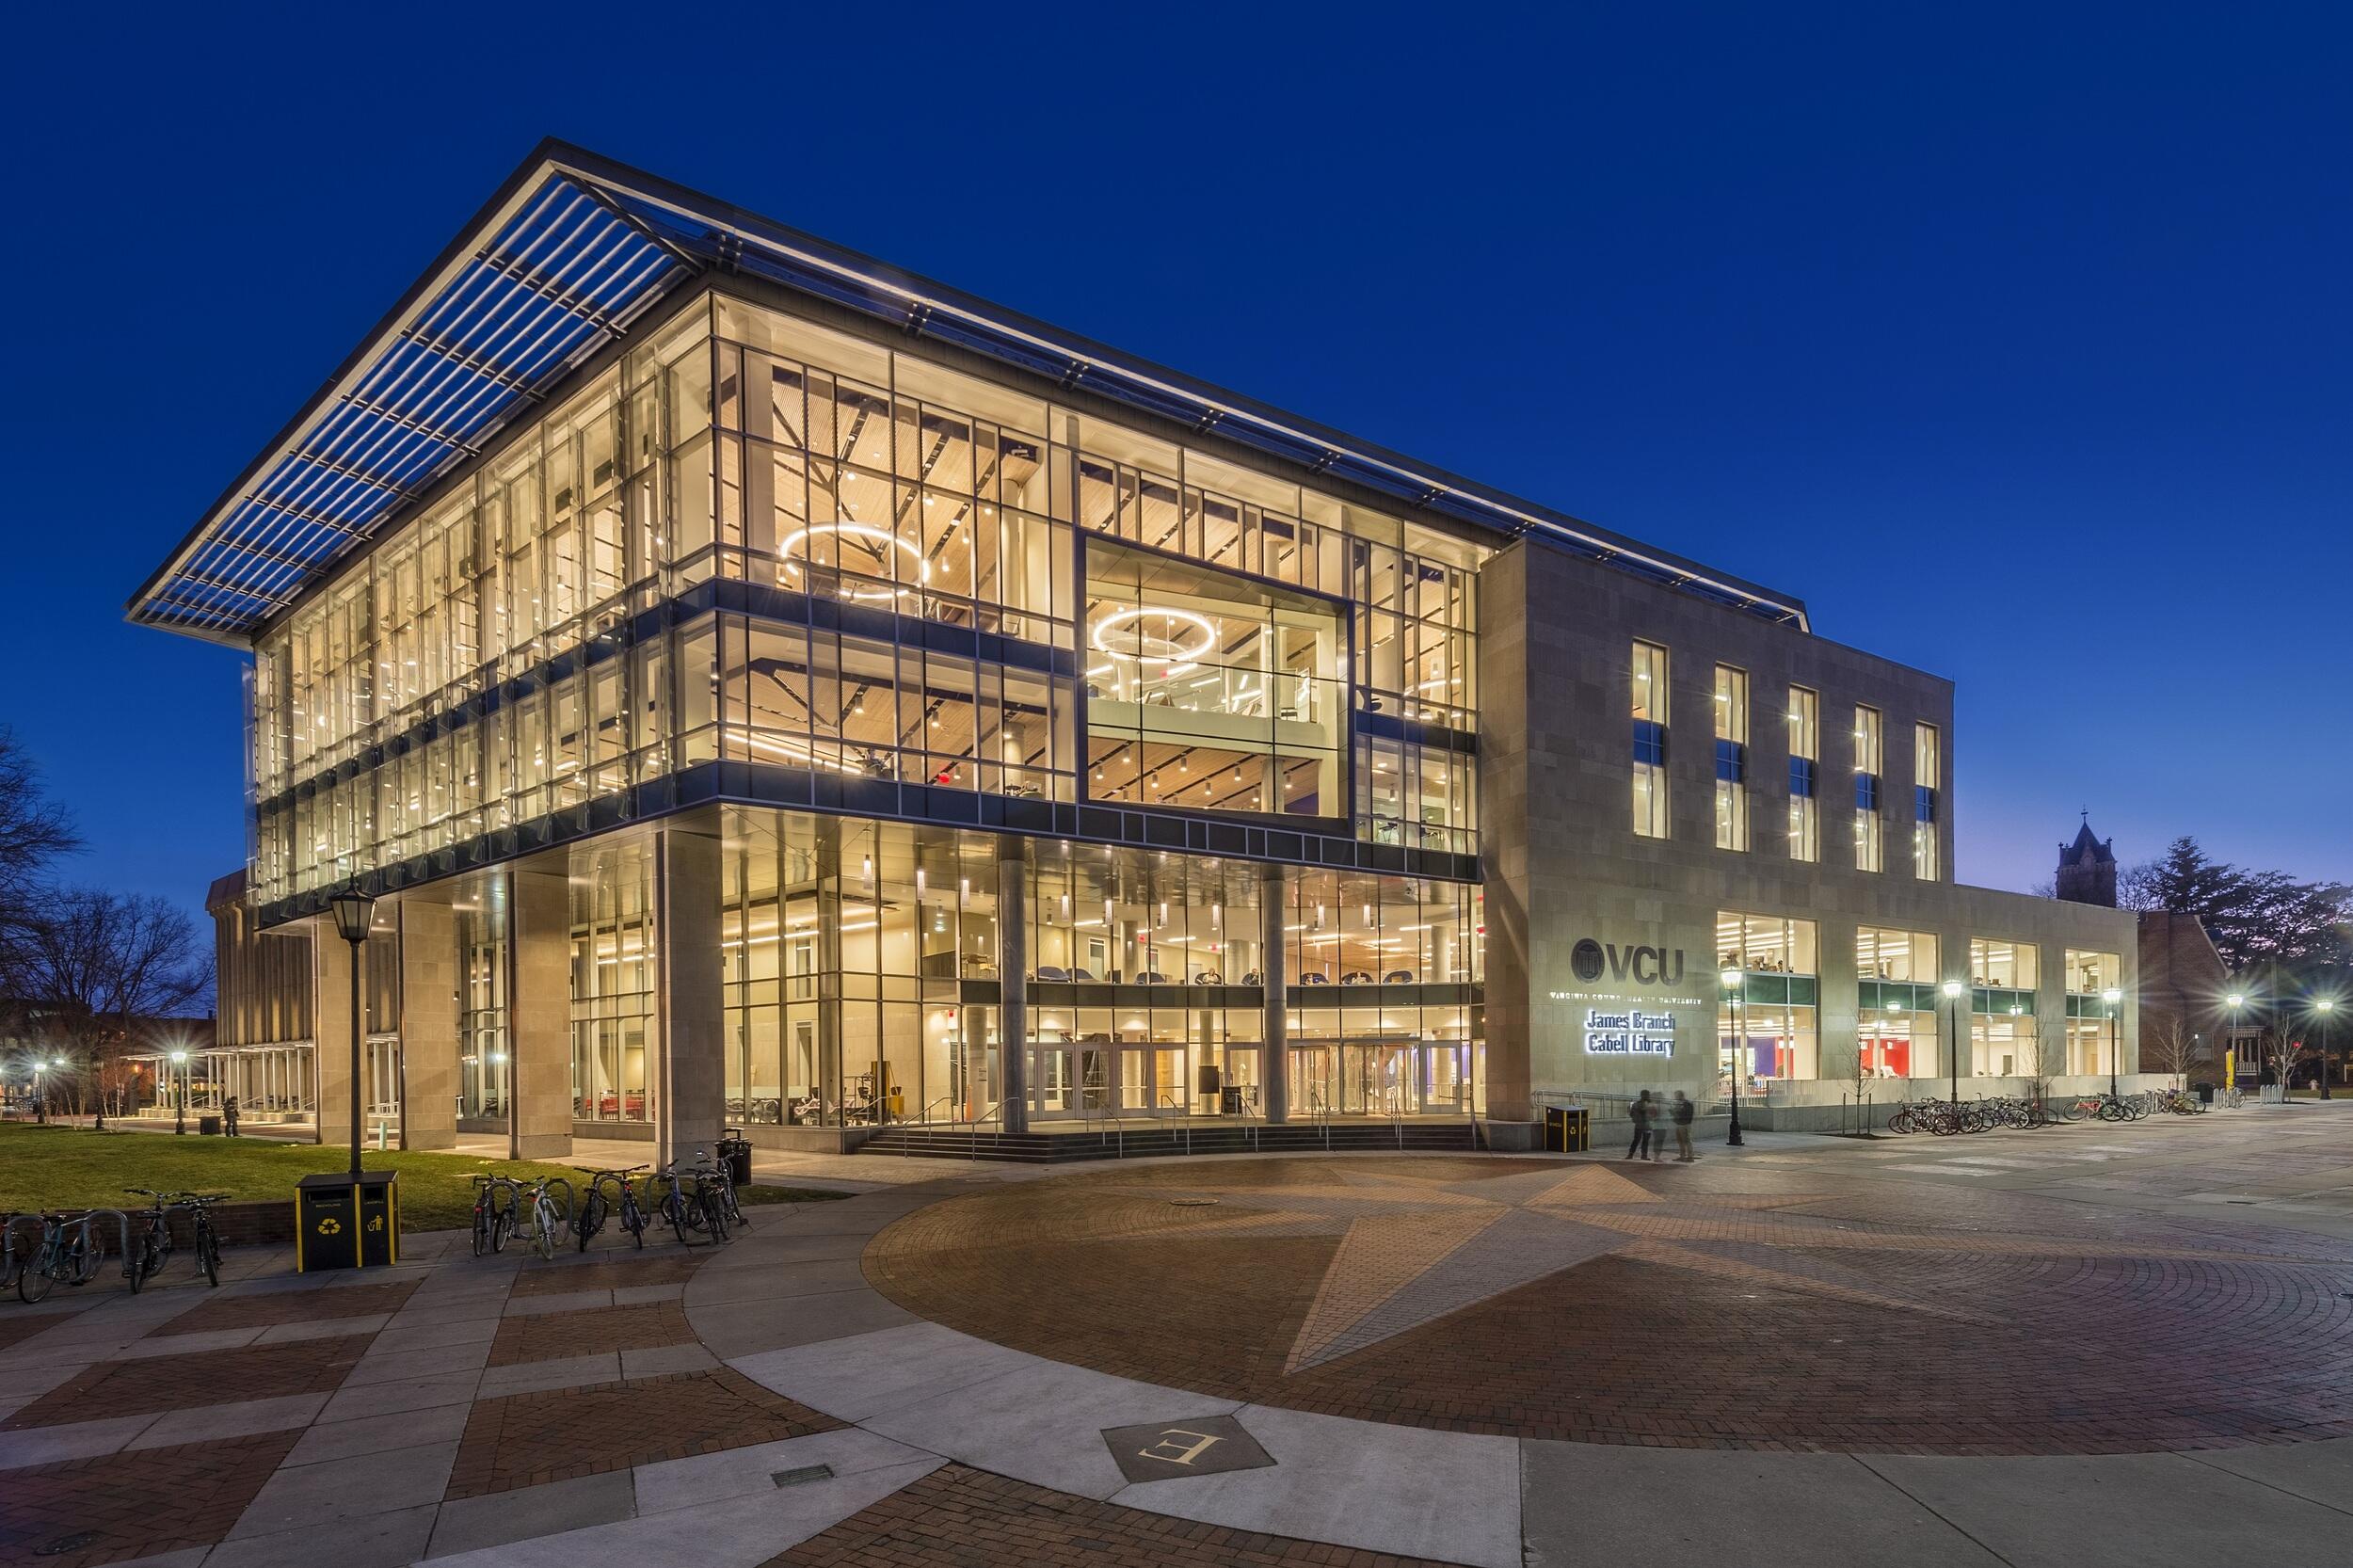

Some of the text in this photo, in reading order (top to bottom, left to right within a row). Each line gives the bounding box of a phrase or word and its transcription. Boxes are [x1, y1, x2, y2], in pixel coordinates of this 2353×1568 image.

[1605, 943, 1684, 986] VCU
[1549, 991, 1702, 1005] VIRGINIA COMMOWEALTH UNIVERSITY
[1586, 1010, 1675, 1031] James Branch
[1587, 1033, 1675, 1057] Cabell Library
[1137, 1428, 1228, 1466] E
